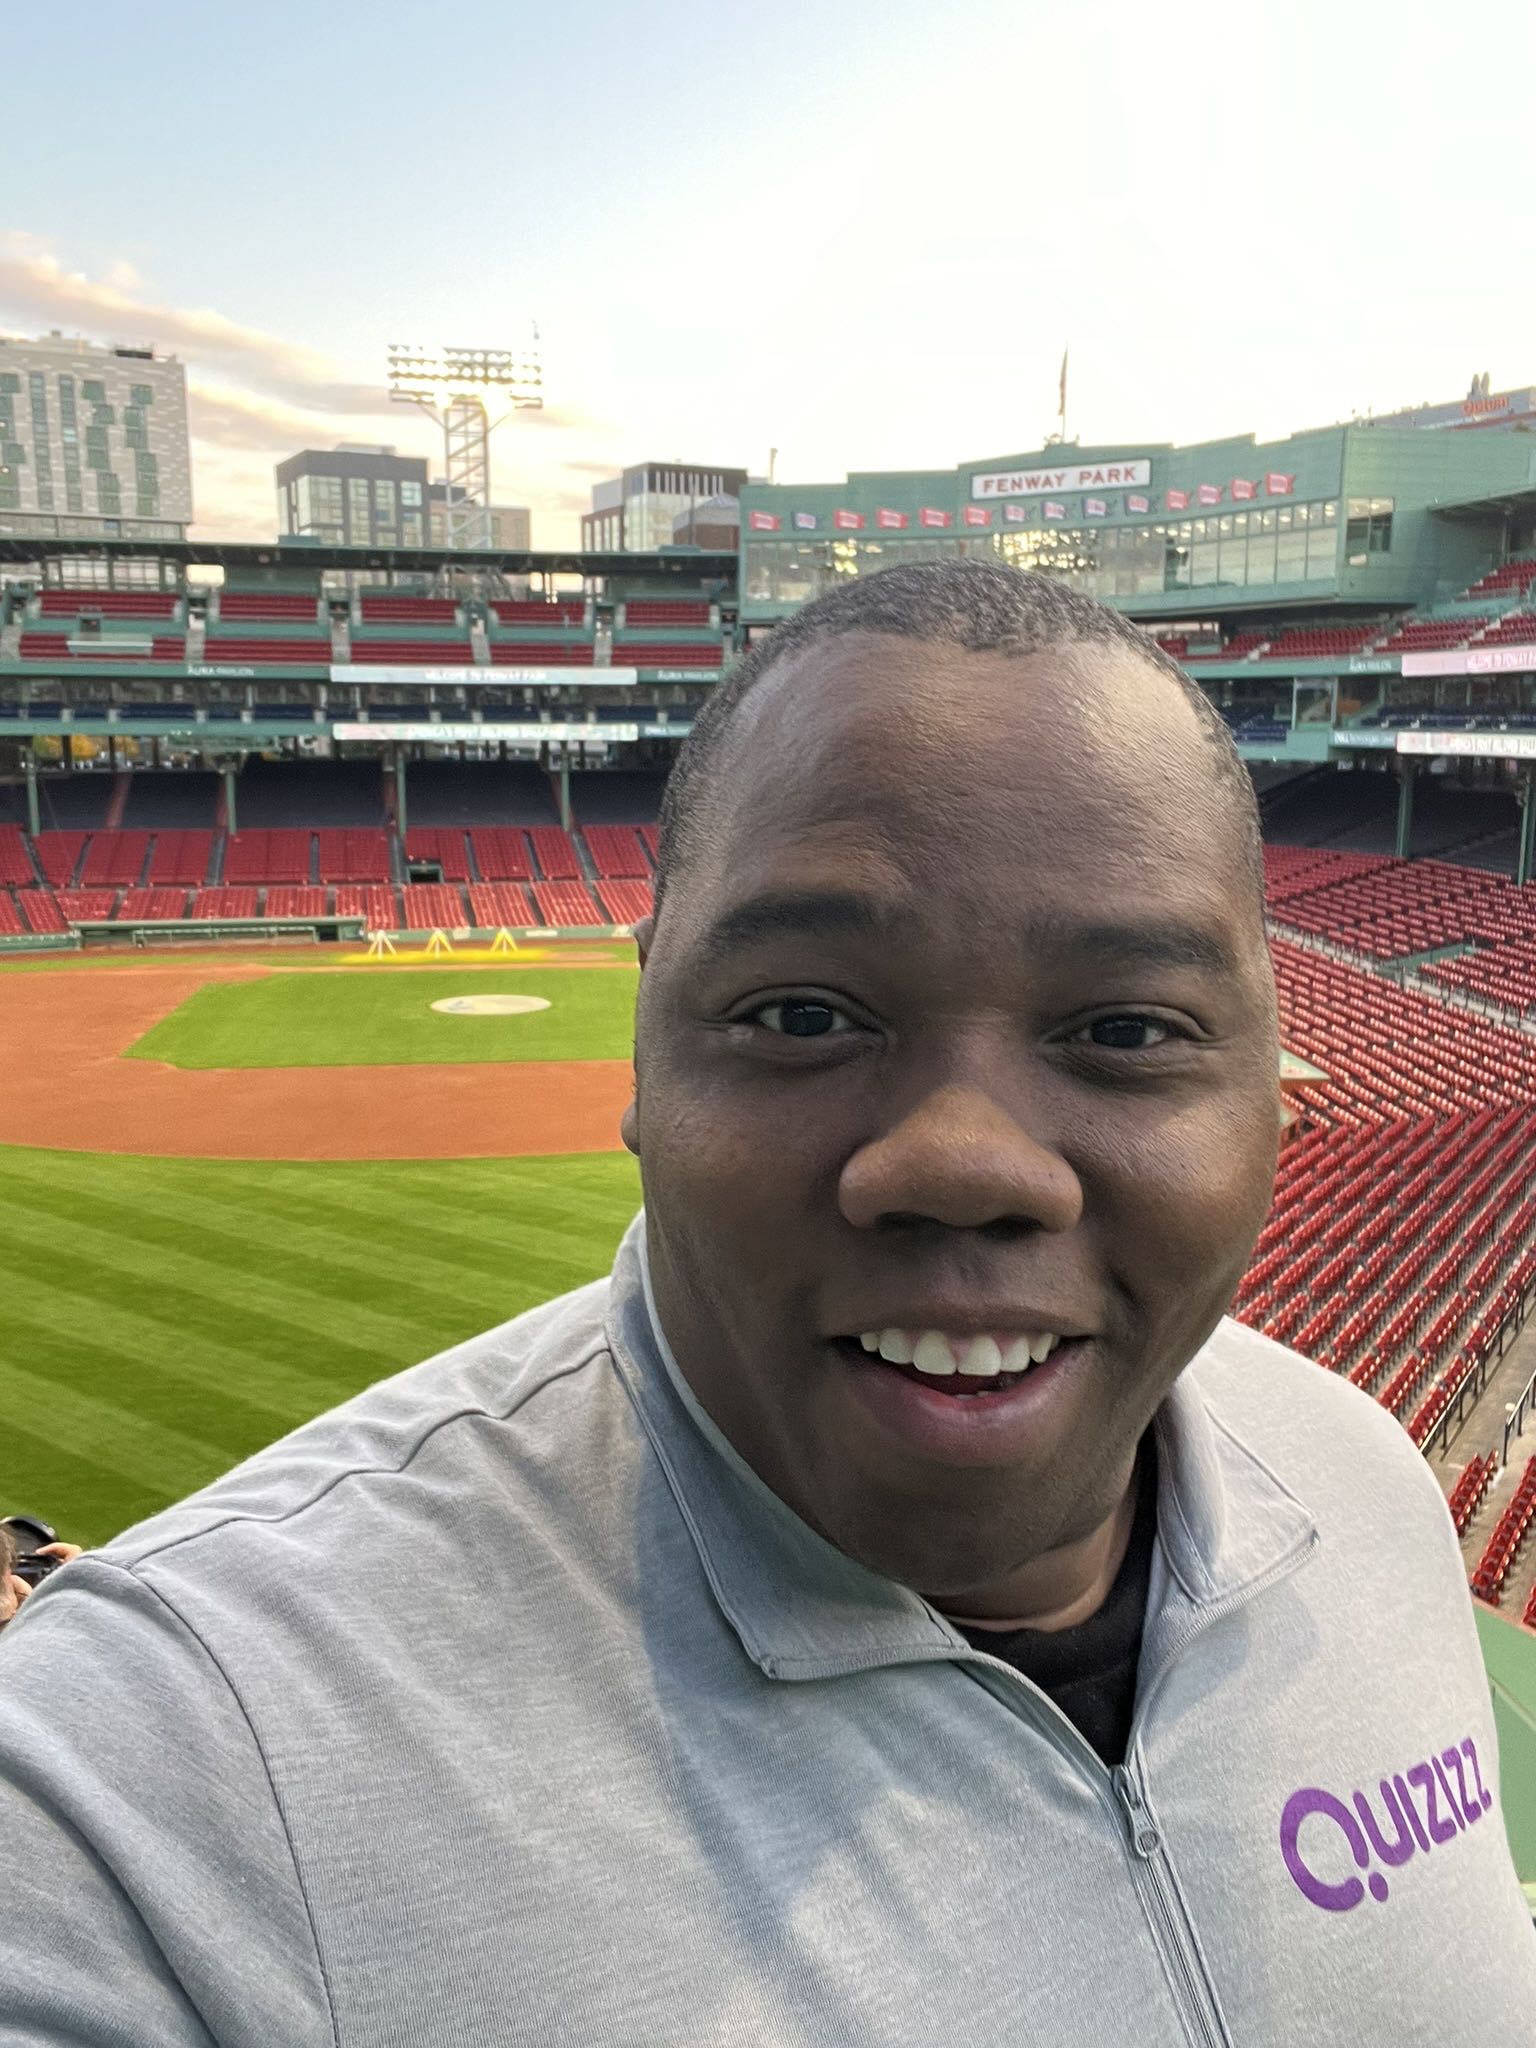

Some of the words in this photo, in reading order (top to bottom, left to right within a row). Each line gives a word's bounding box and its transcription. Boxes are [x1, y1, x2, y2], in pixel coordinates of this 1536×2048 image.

[982, 473, 1066, 493] FENWAY
[1078, 467, 1137, 486] PARK
[1280, 1736, 1492, 1911] QUIZIZZ
